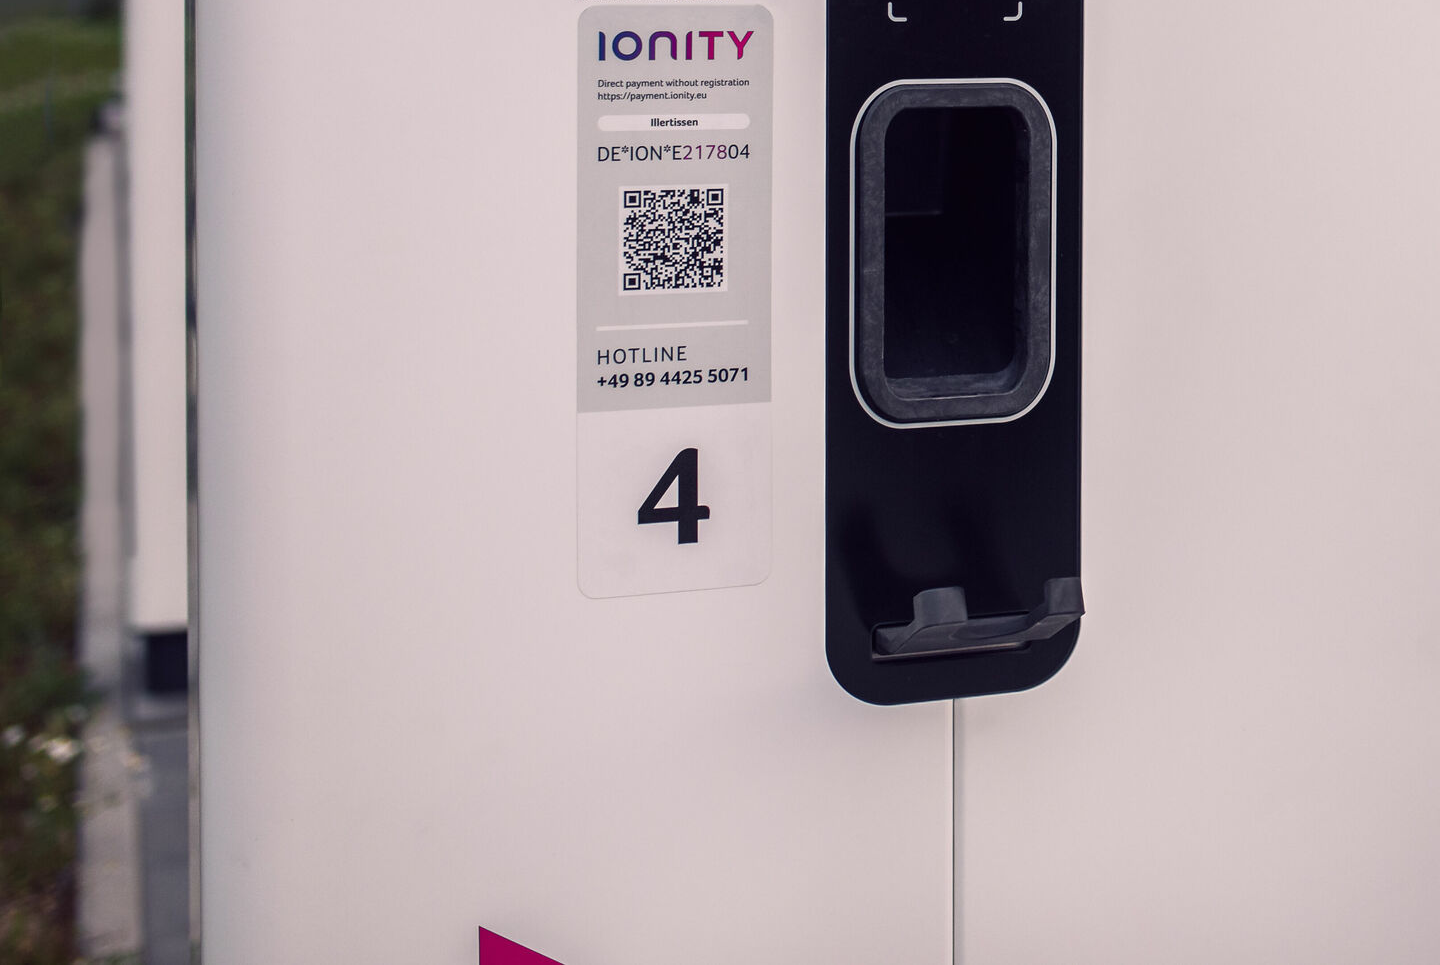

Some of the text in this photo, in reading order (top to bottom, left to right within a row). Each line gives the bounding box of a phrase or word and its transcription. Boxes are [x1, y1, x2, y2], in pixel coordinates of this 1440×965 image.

[598, 30, 755, 61] IONITY
[597, 79, 750, 89] Direct payment without registration
[597, 91, 707, 102] https://payment.ionity.eu
[651, 118, 699, 127] Illertissen
[597, 345, 687, 365] HOTLINE
[597, 367, 750, 389] +49 89 4425 5071
[637, 447, 711, 545] 4
